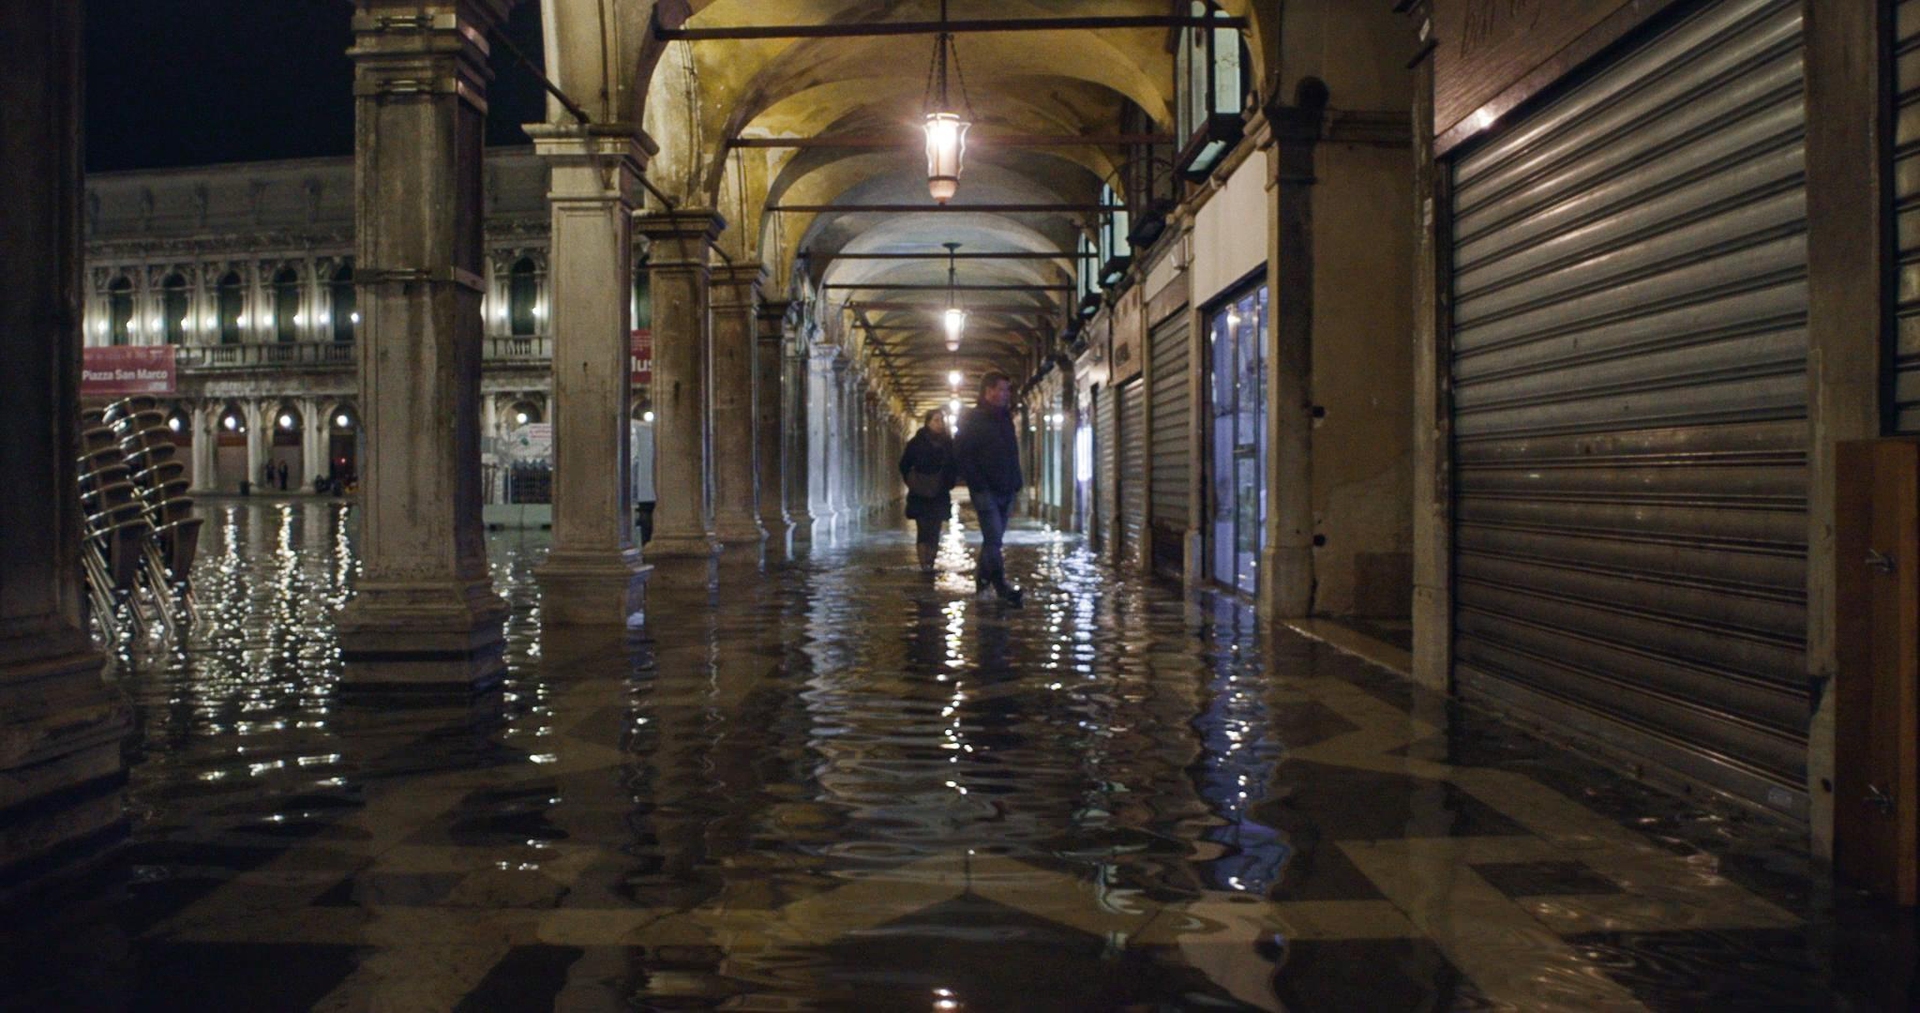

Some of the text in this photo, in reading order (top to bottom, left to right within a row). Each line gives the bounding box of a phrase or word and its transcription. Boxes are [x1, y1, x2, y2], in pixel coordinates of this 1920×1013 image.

[82, 369, 168, 380] Piazza San Marco
